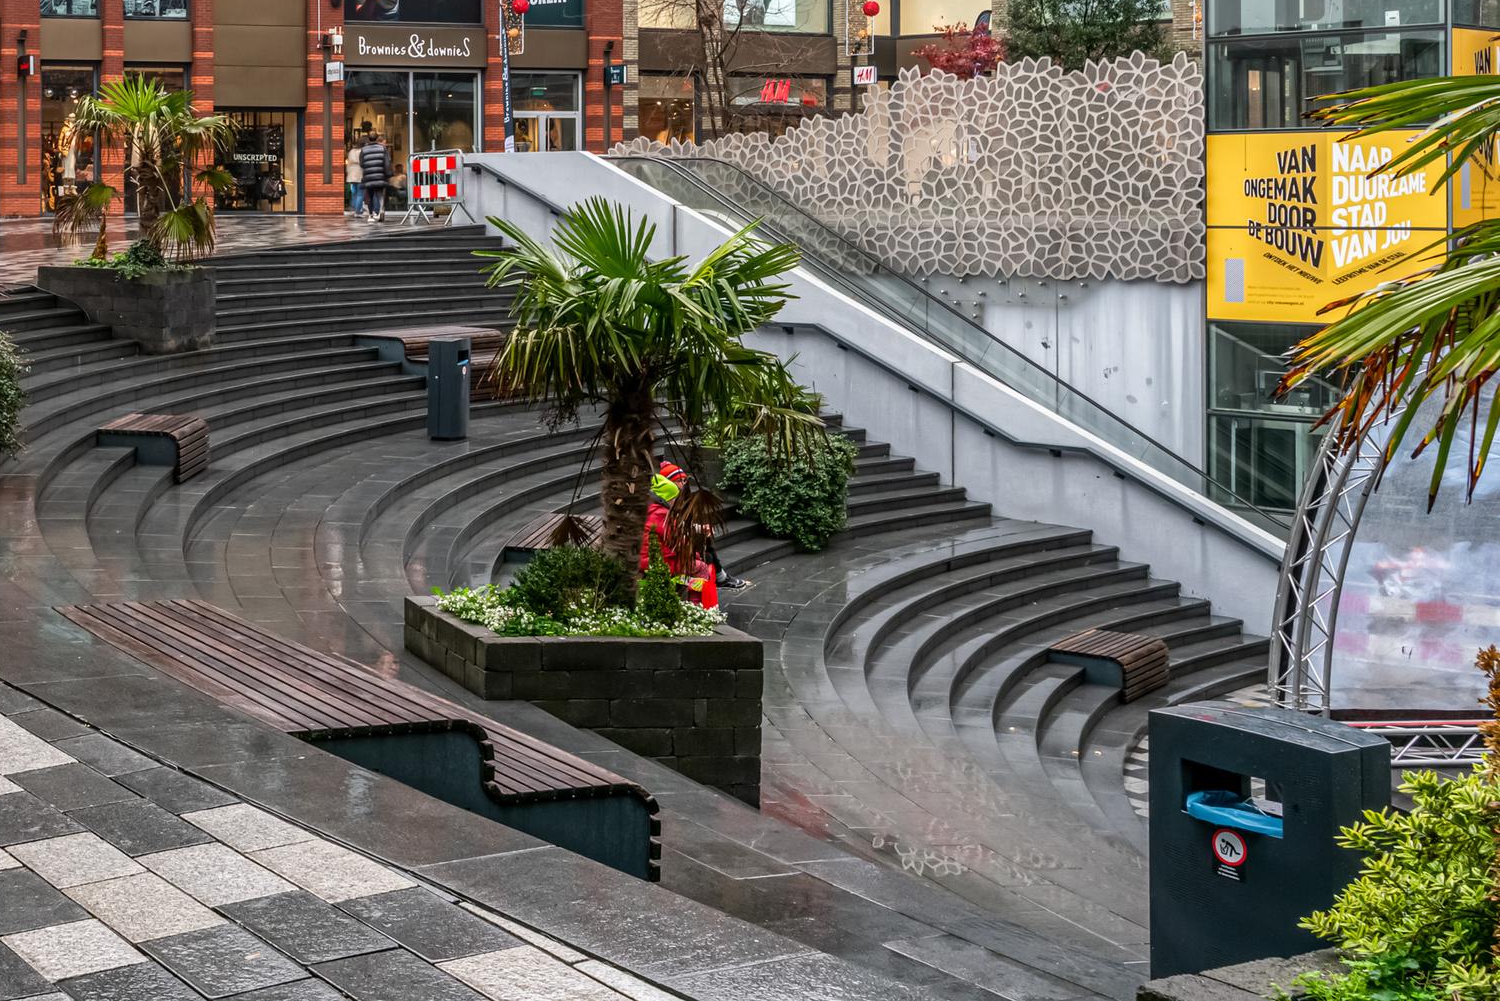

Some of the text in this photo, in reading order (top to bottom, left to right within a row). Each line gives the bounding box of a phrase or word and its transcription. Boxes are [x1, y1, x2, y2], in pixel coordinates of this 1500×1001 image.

[359, 36, 406, 56] Brownies
[1474, 47, 1491, 75] VAN
[233, 153, 278, 162] UNSCRIPTED
[1277, 144, 1317, 174] VAN
[1244, 176, 1317, 205] ONGEMAK
[1332, 172, 1426, 206] DUURZAME
[1268, 202, 1317, 235] DOOR
[1332, 201, 1387, 236] STAD
[1248, 219, 1325, 269] DE BOUW
[1331, 220, 1411, 268] VAN JOU
